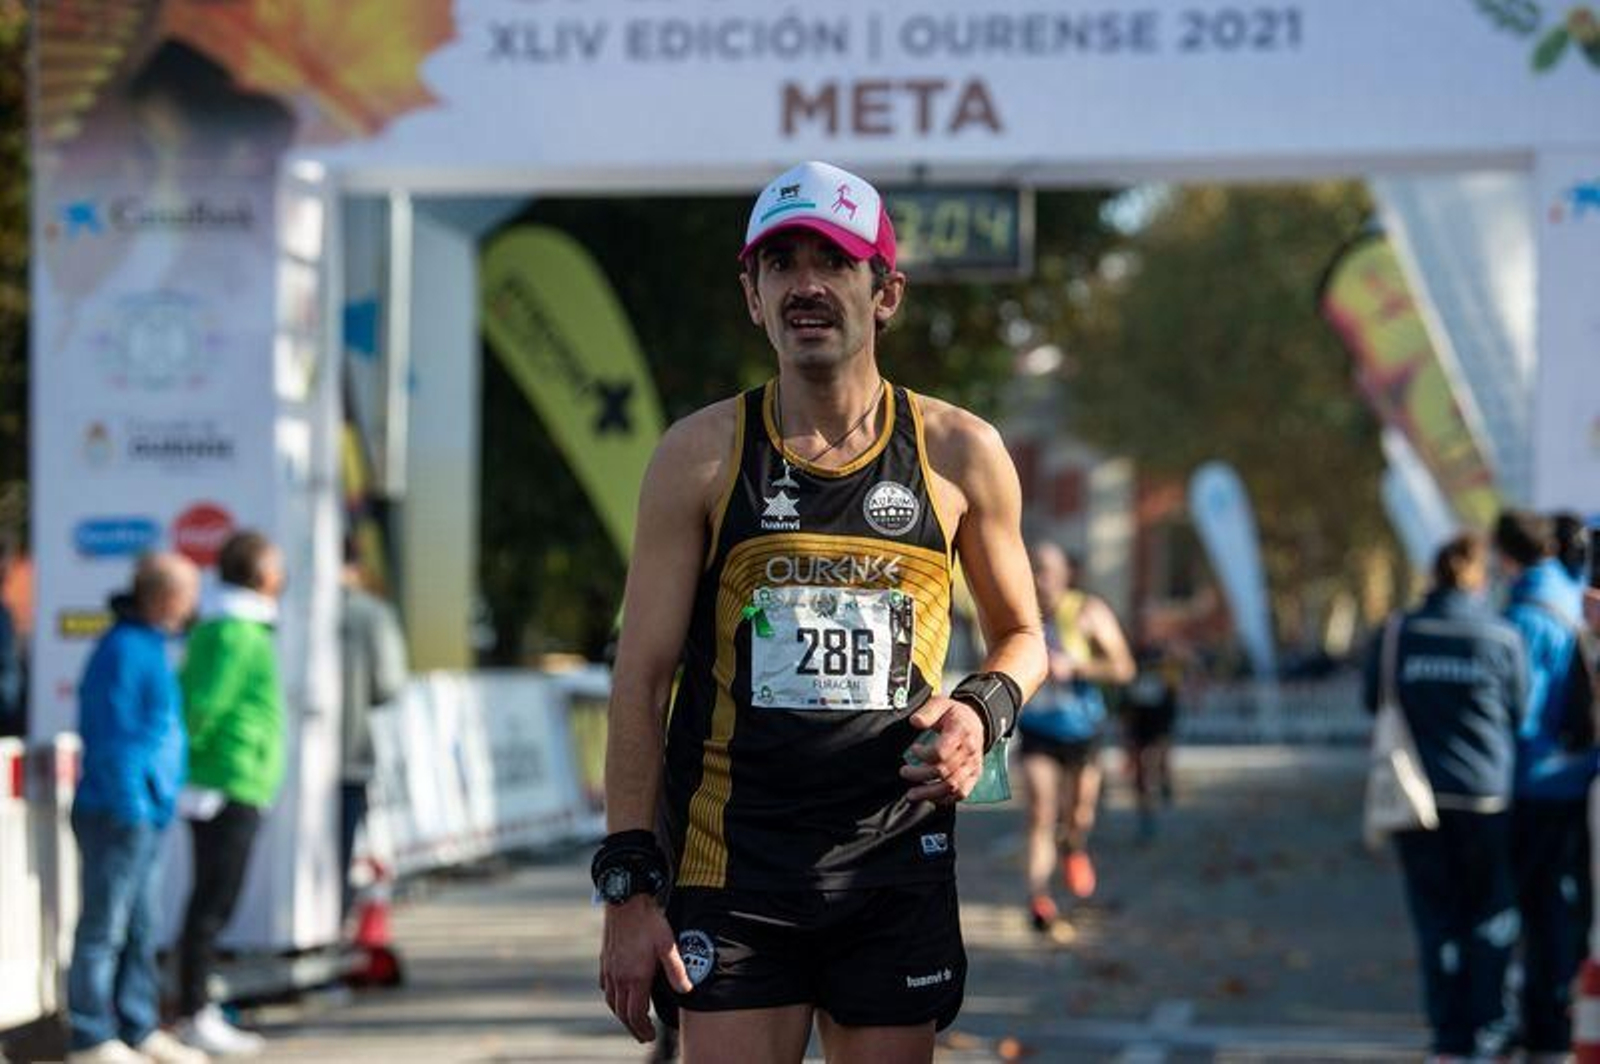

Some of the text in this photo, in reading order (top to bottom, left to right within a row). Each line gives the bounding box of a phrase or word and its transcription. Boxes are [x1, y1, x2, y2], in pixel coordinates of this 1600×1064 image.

[487, 6, 1303, 63] XLIV EDICIÓN OURENSE 2021
[780, 80, 1003, 136] META
[765, 554, 904, 585] OURENSE
[796, 627, 874, 676] 286
